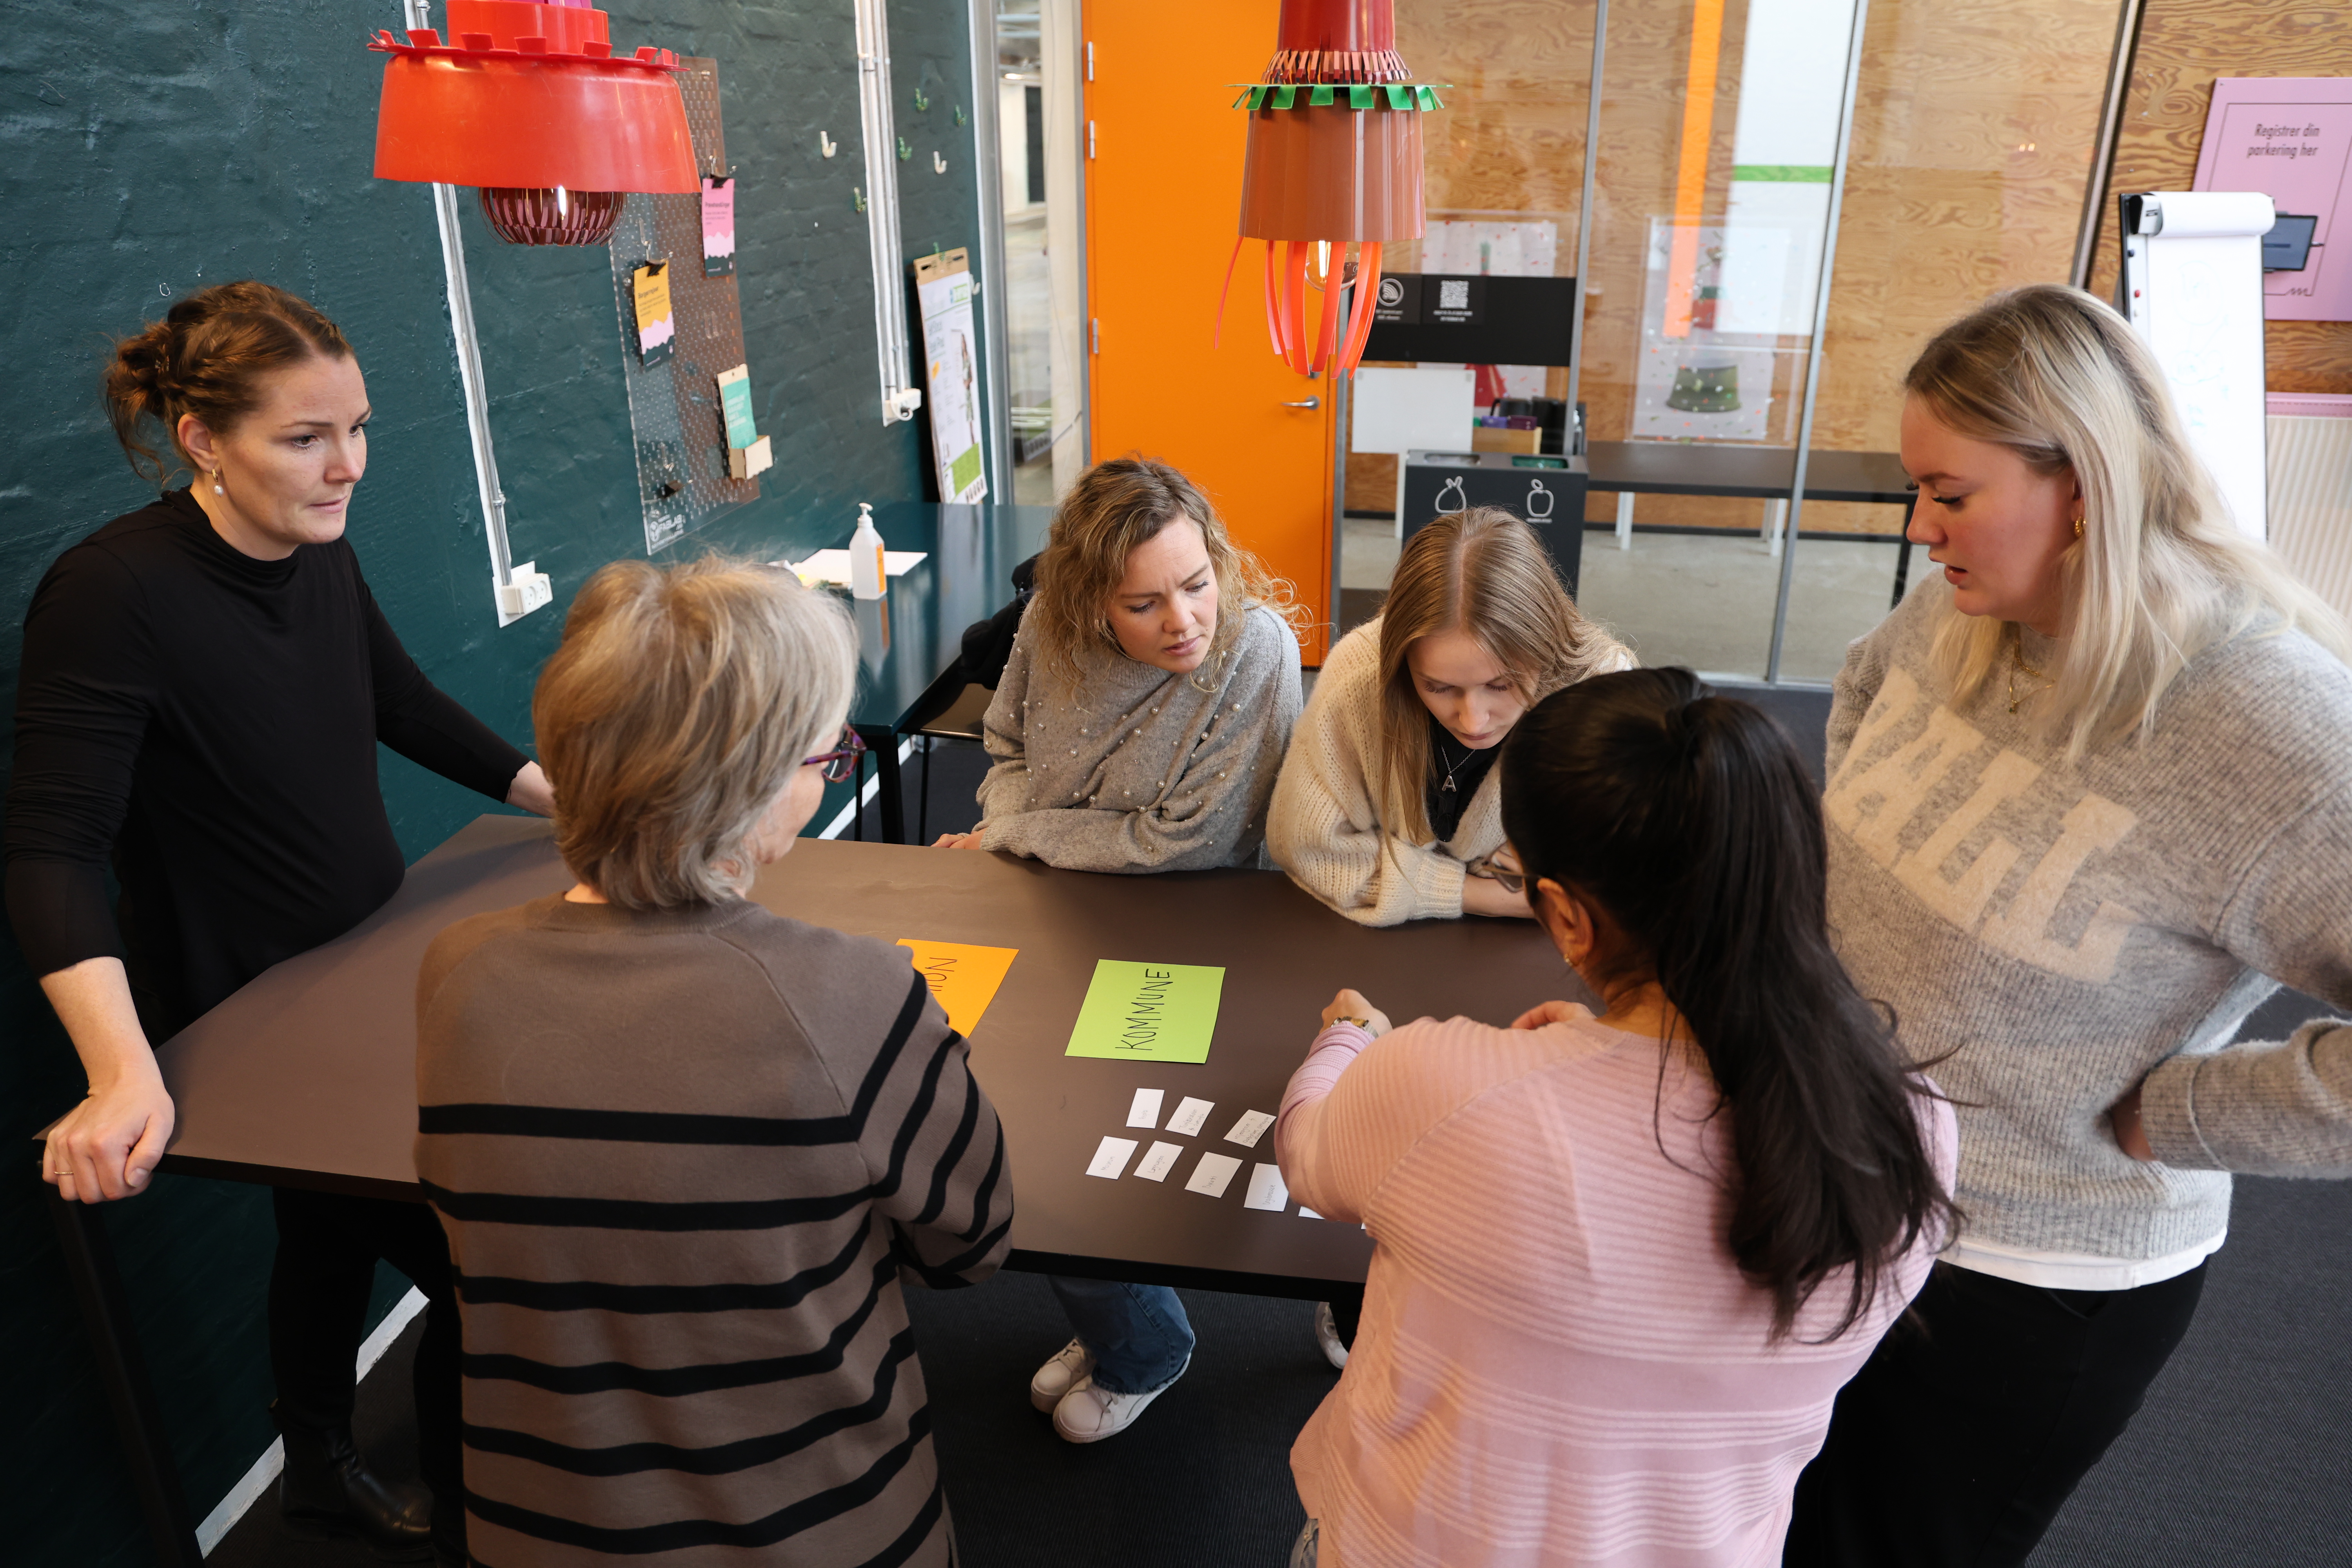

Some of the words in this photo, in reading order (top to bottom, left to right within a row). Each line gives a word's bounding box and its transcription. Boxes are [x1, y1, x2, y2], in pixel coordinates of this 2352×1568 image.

[2255, 123, 2300, 140] Registrer
[2303, 122, 2320, 136] din
[2246, 142, 2298, 159] parkering
[2300, 142, 2319, 156] her
[923, 957, 958, 996] ION
[1115, 968, 1173, 1051] KOMMUNE
[1100, 1156, 1115, 1170] Museum
